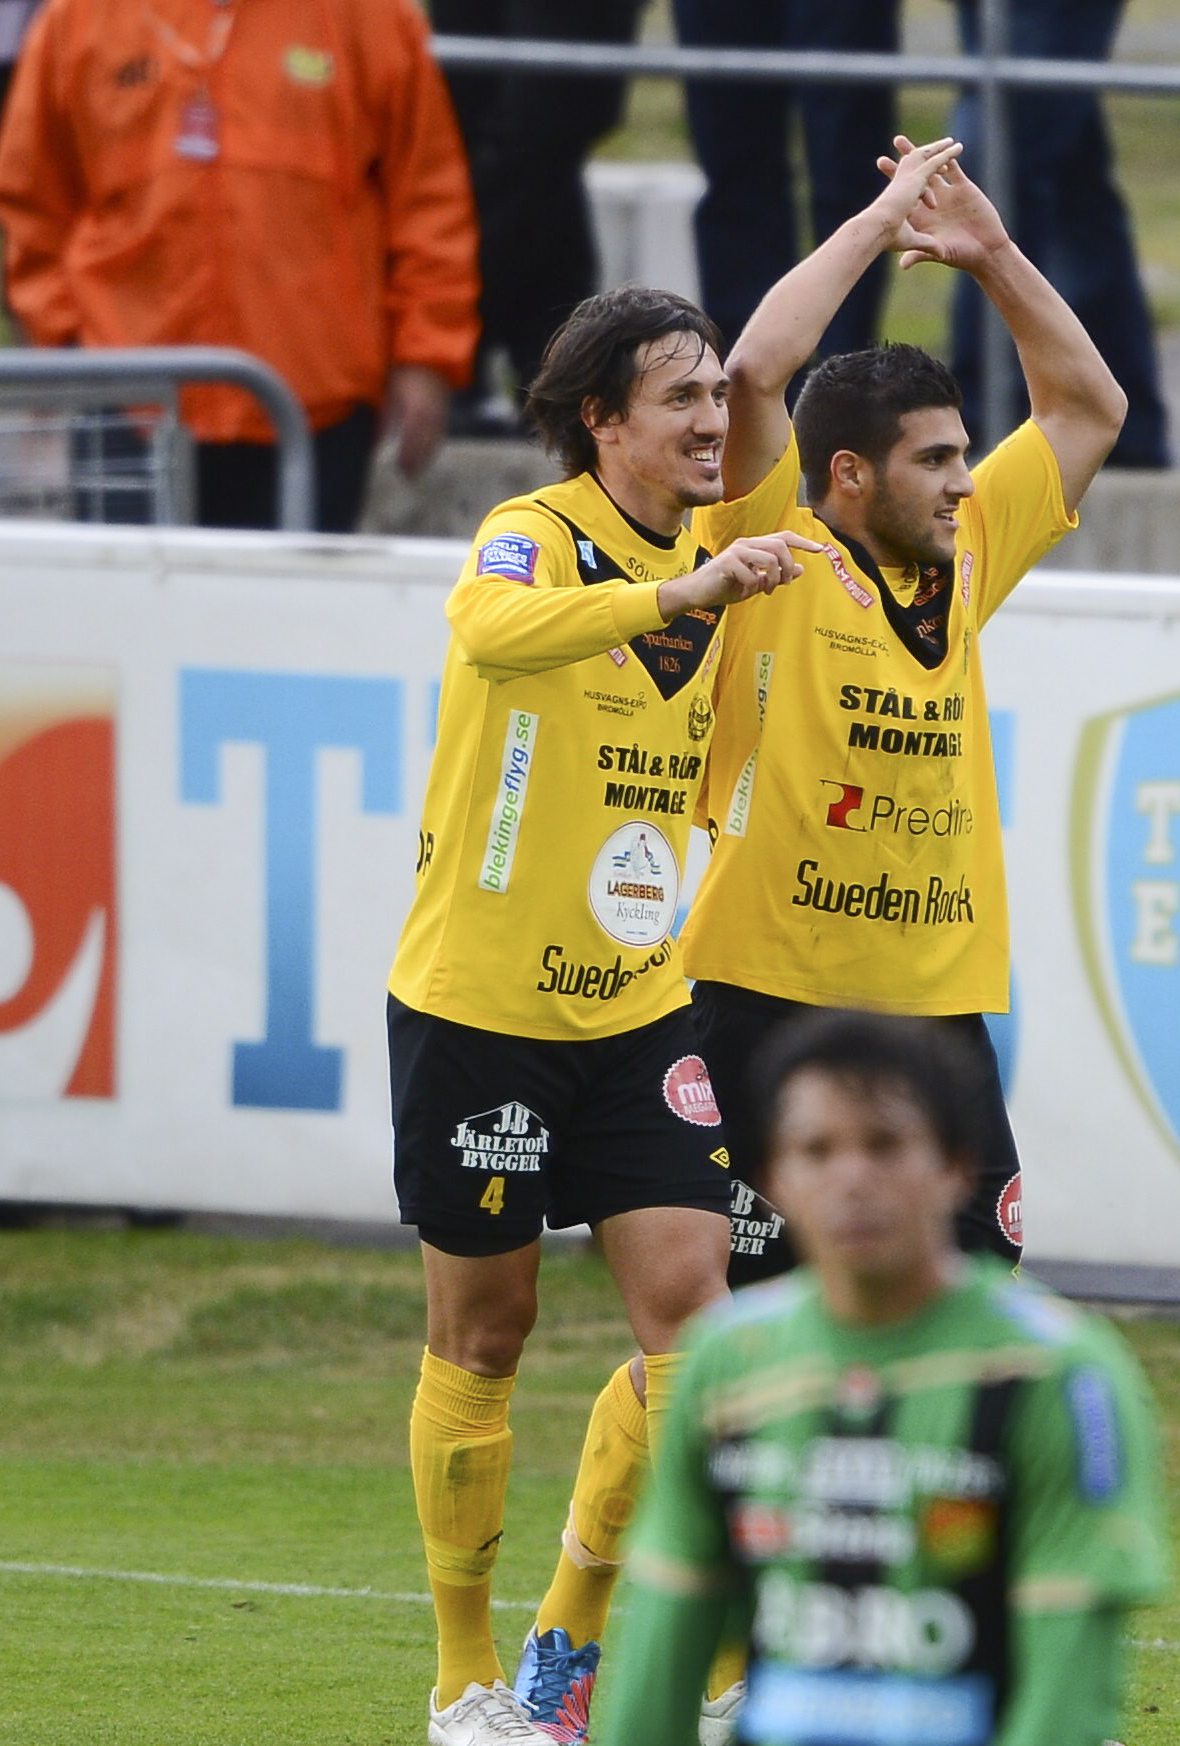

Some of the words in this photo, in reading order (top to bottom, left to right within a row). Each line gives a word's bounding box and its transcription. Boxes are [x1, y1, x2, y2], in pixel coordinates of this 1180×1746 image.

[658, 655, 681, 673] 1826
[839, 684, 918, 721] STÅL
[923, 700, 941, 722] &
[597, 743, 648, 775] STÅL
[649, 756, 664, 777] &
[484, 713, 531, 890] blekingeflyg.se
[604, 782, 687, 815] MONTAGE
[607, 879, 665, 902] LAGERBERG
[791, 859, 921, 924] Sweden
[924, 873, 974, 926] Rock
[616, 901, 661, 925] Kyckling
[537, 944, 636, 1001] Swede
[450, 1121, 550, 1153] JÄRLETOFT
[461, 1149, 541, 1172] BYGGER
[479, 1177, 506, 1215] 4
